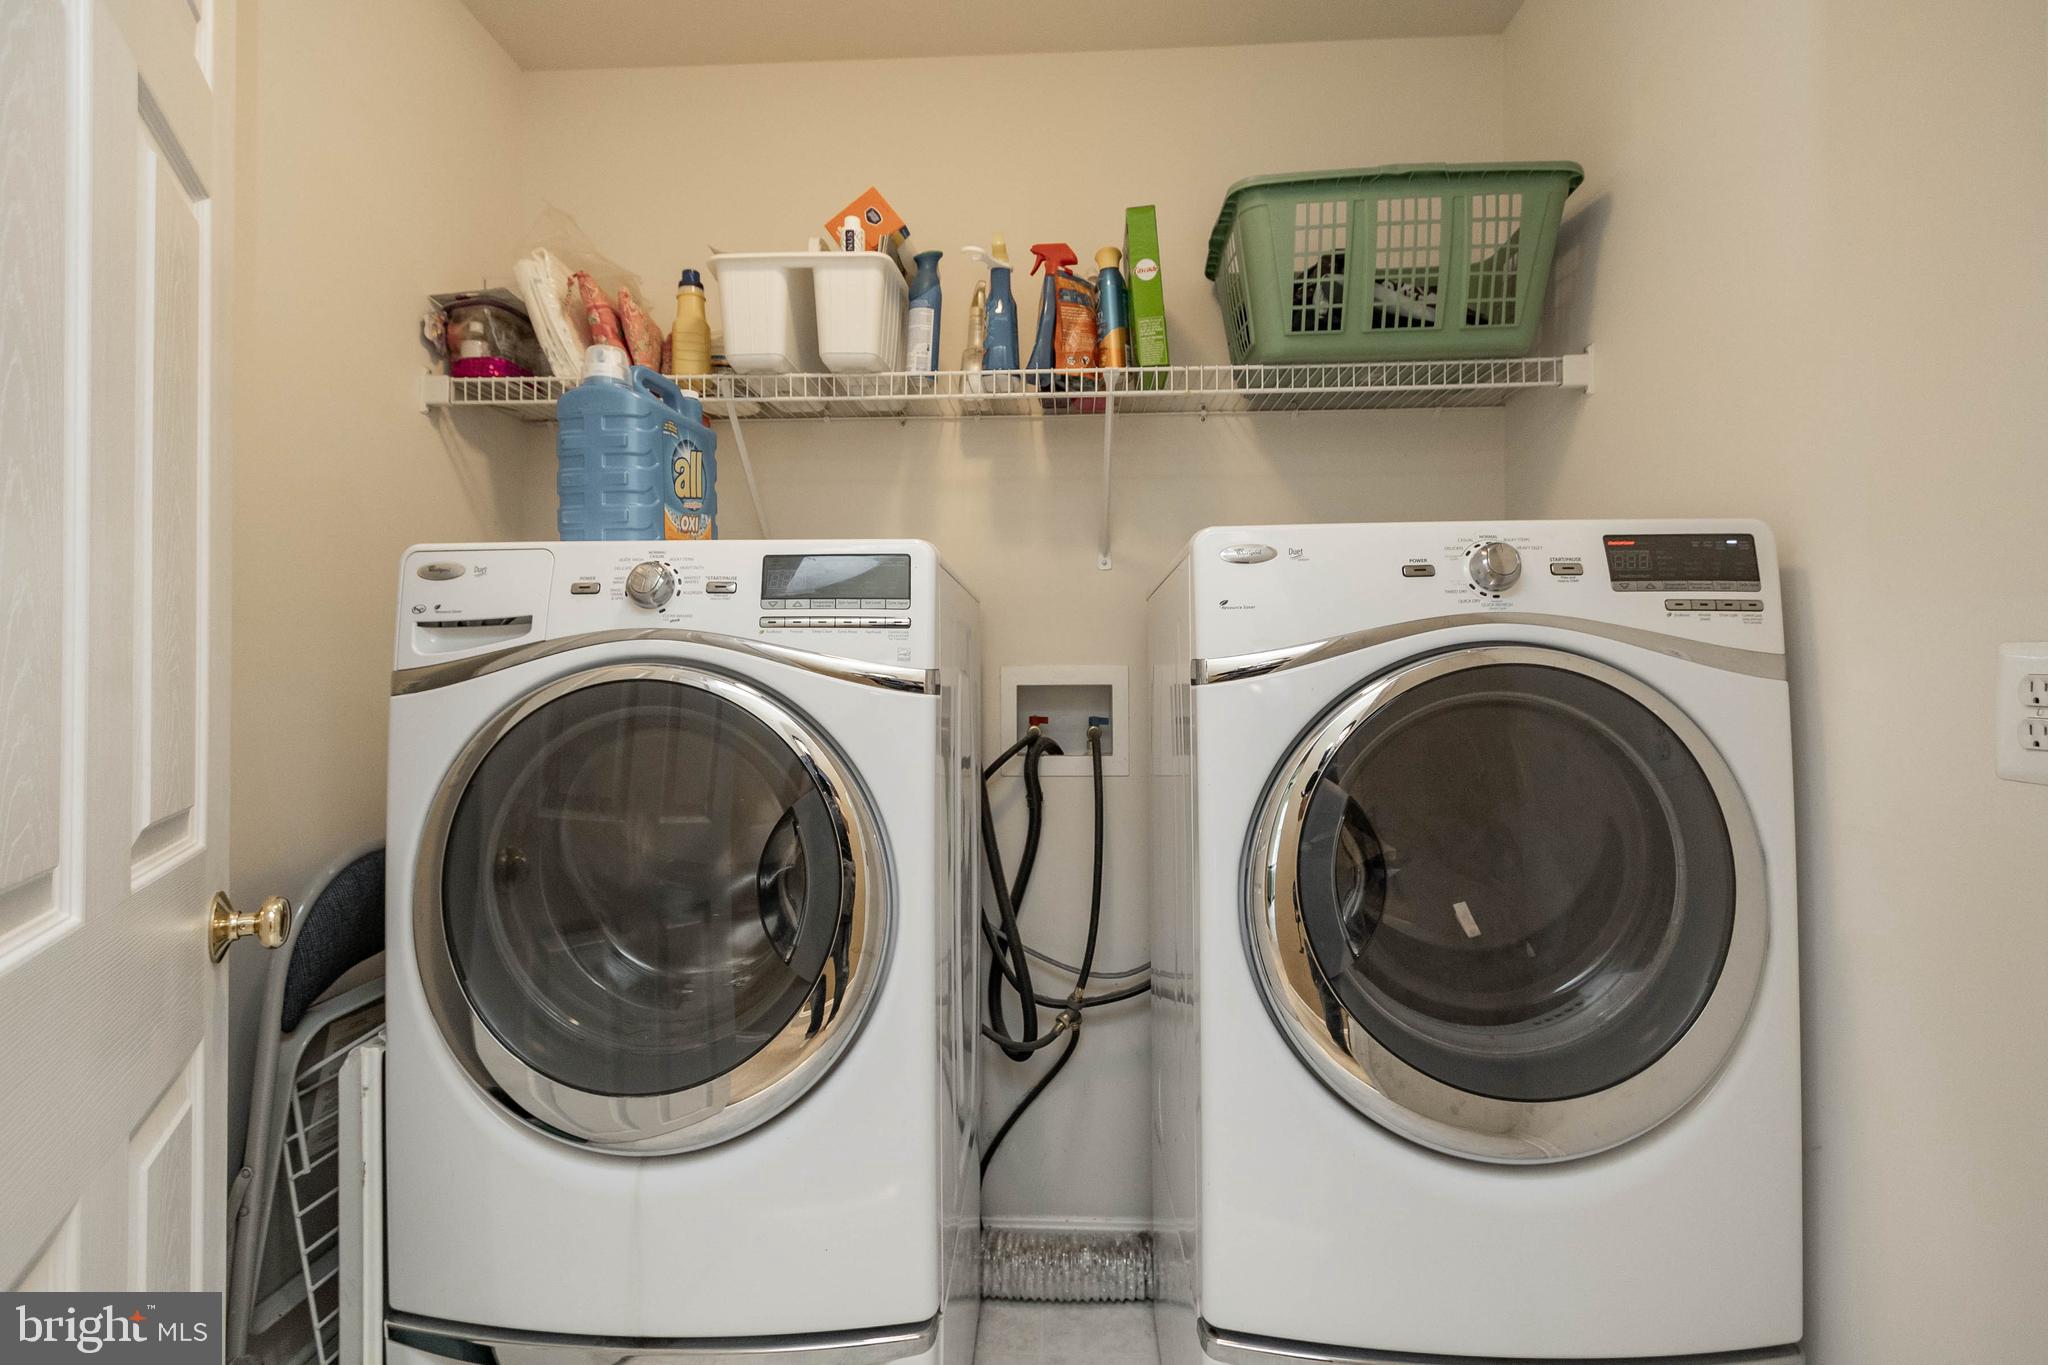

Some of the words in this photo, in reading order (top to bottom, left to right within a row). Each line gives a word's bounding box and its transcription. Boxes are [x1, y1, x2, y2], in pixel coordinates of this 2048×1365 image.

[674, 450, 703, 499] all
[680, 514, 699, 532] OXI
[1288, 547, 1303, 556] Duet
